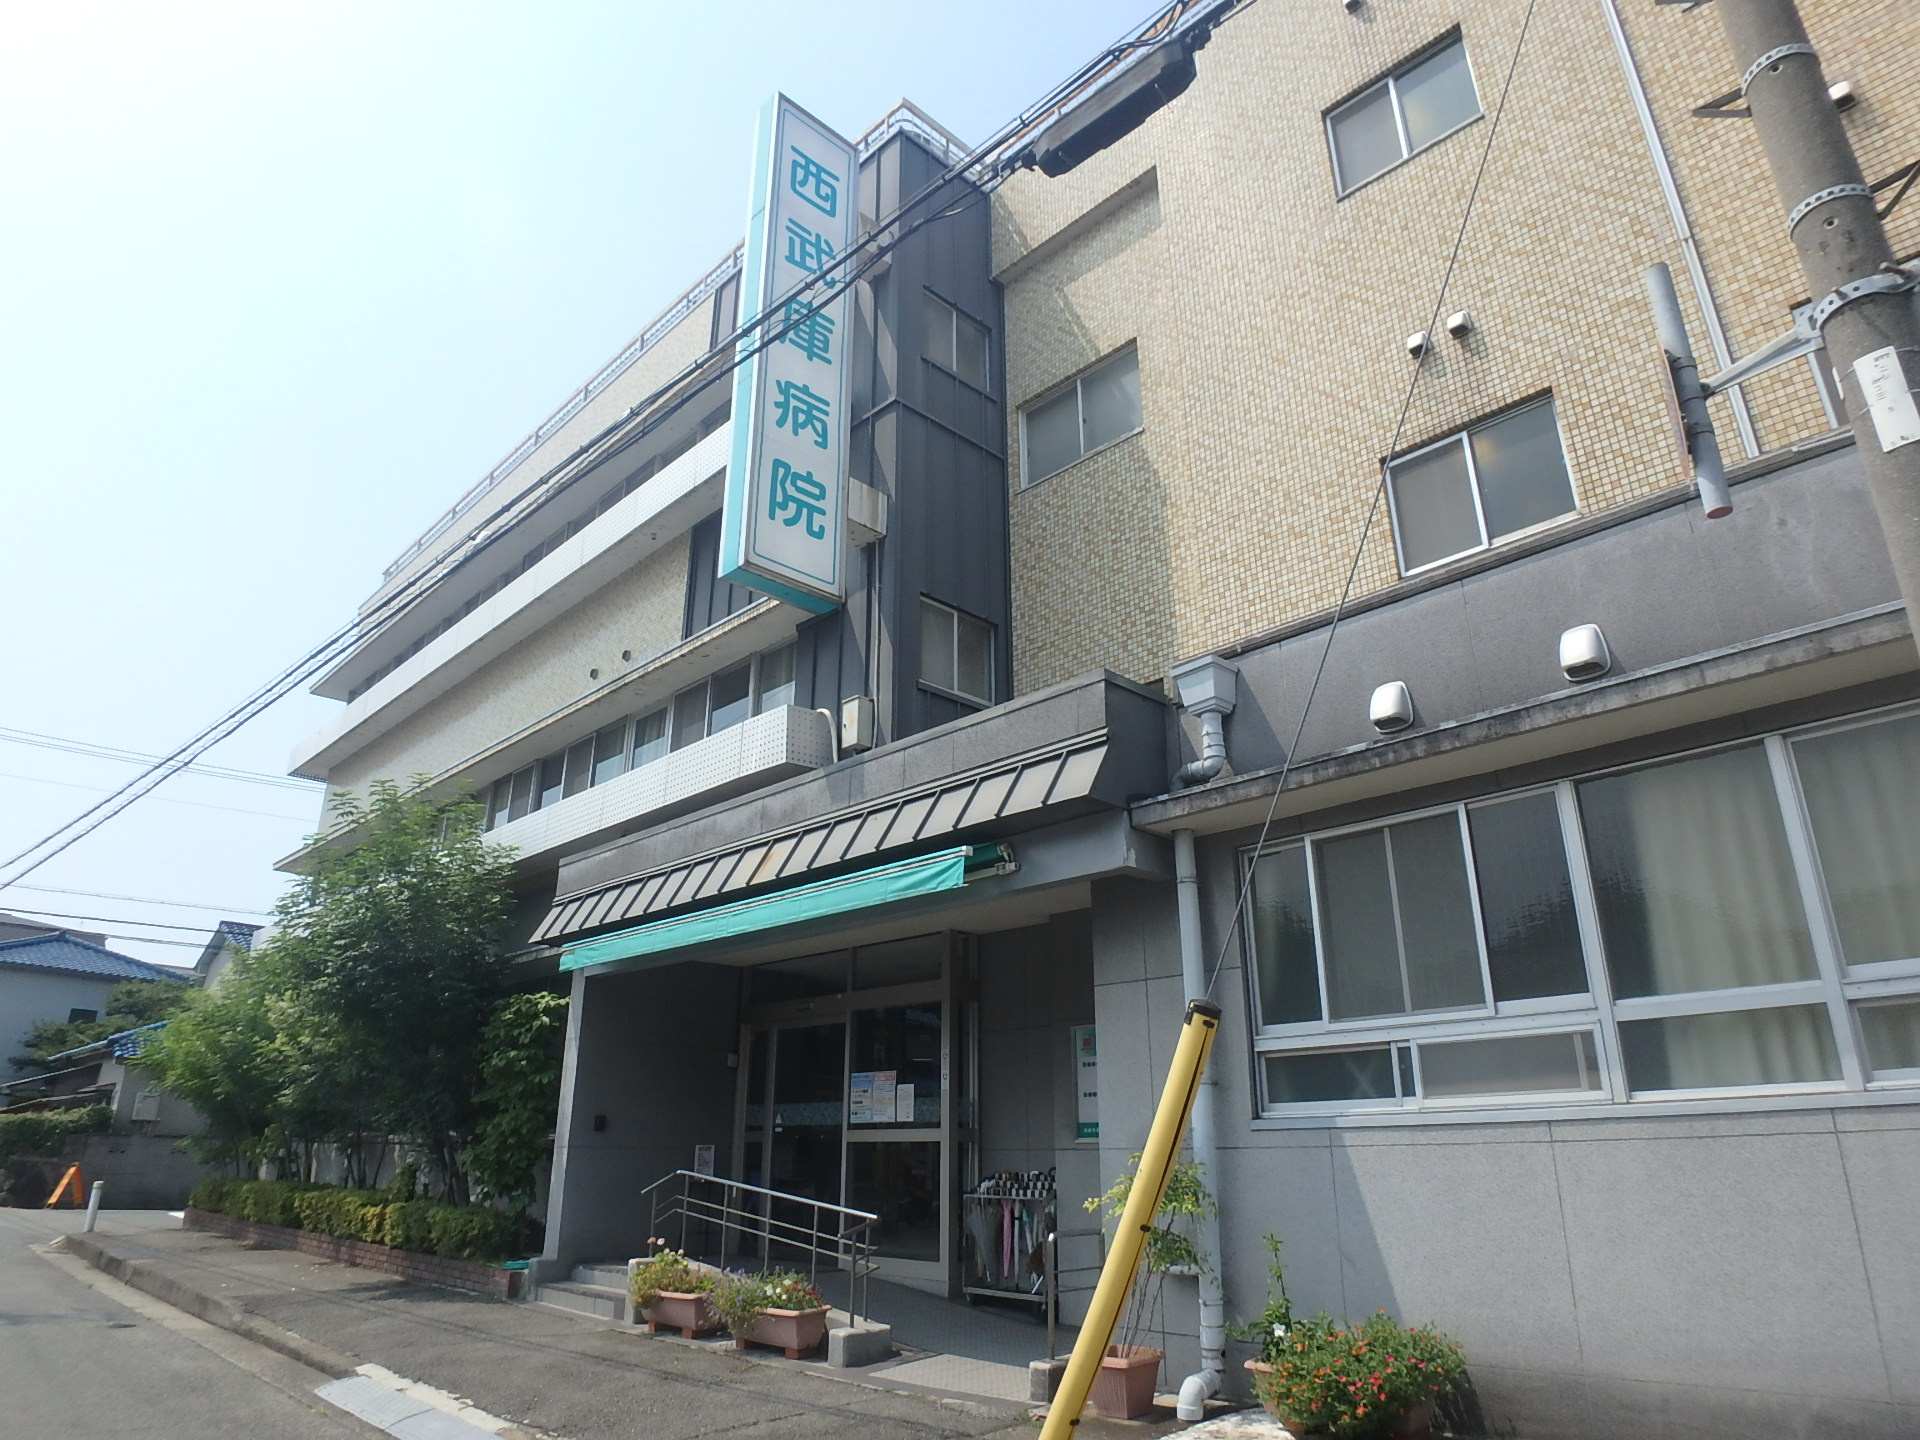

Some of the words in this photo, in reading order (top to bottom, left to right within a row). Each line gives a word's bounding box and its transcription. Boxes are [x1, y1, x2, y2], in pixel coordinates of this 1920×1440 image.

[768, 145, 840, 541] 西武庫病院
